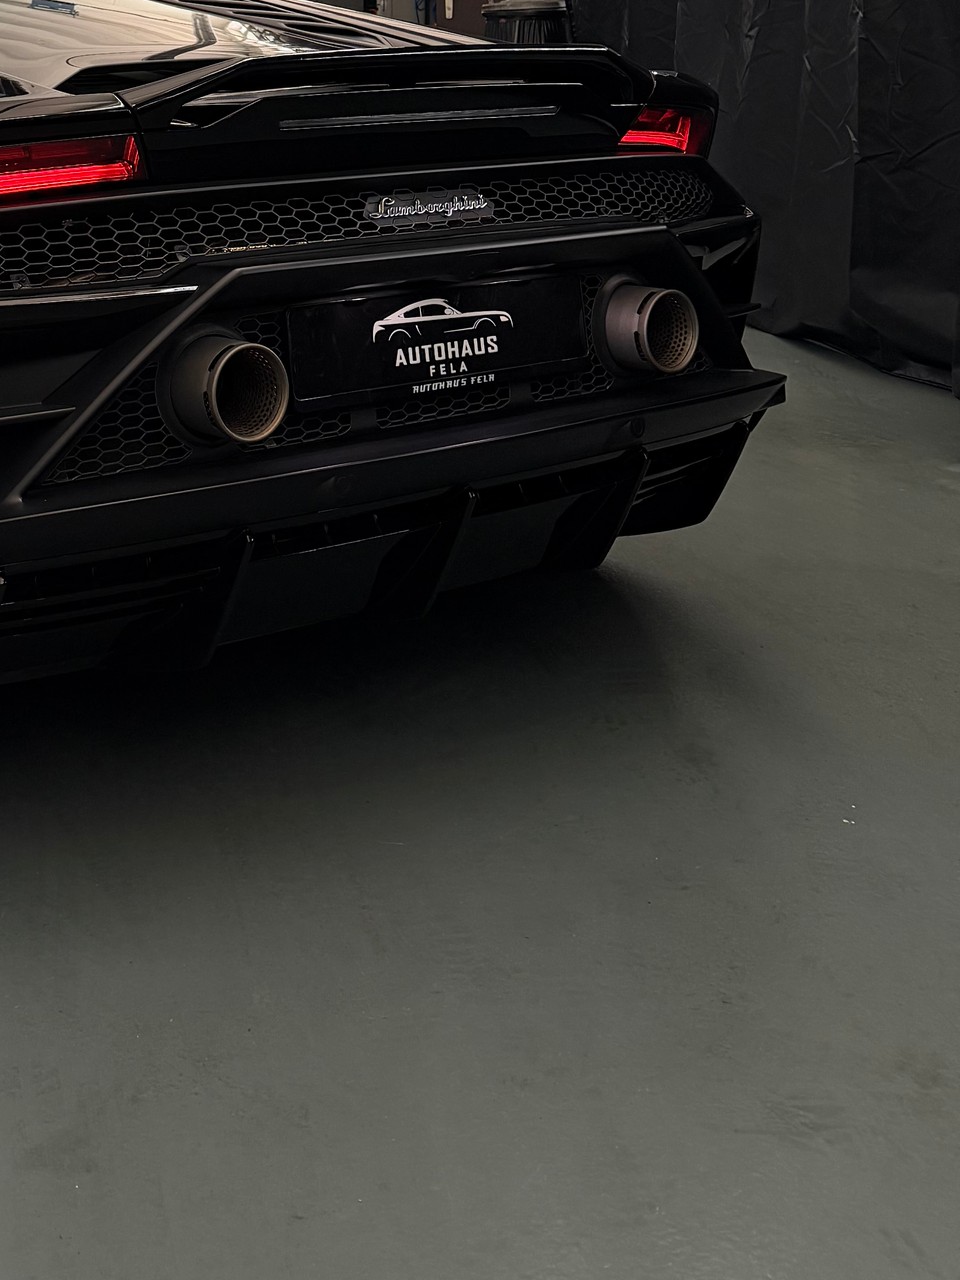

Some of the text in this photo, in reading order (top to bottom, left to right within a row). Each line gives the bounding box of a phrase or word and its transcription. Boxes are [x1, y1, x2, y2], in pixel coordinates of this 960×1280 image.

[369, 194, 488, 219] Lamborghini
[395, 335, 499, 367] AUTOHAUS
[429, 361, 468, 377] FELA
[412, 373, 495, 394] AUTOHAUS FELA
